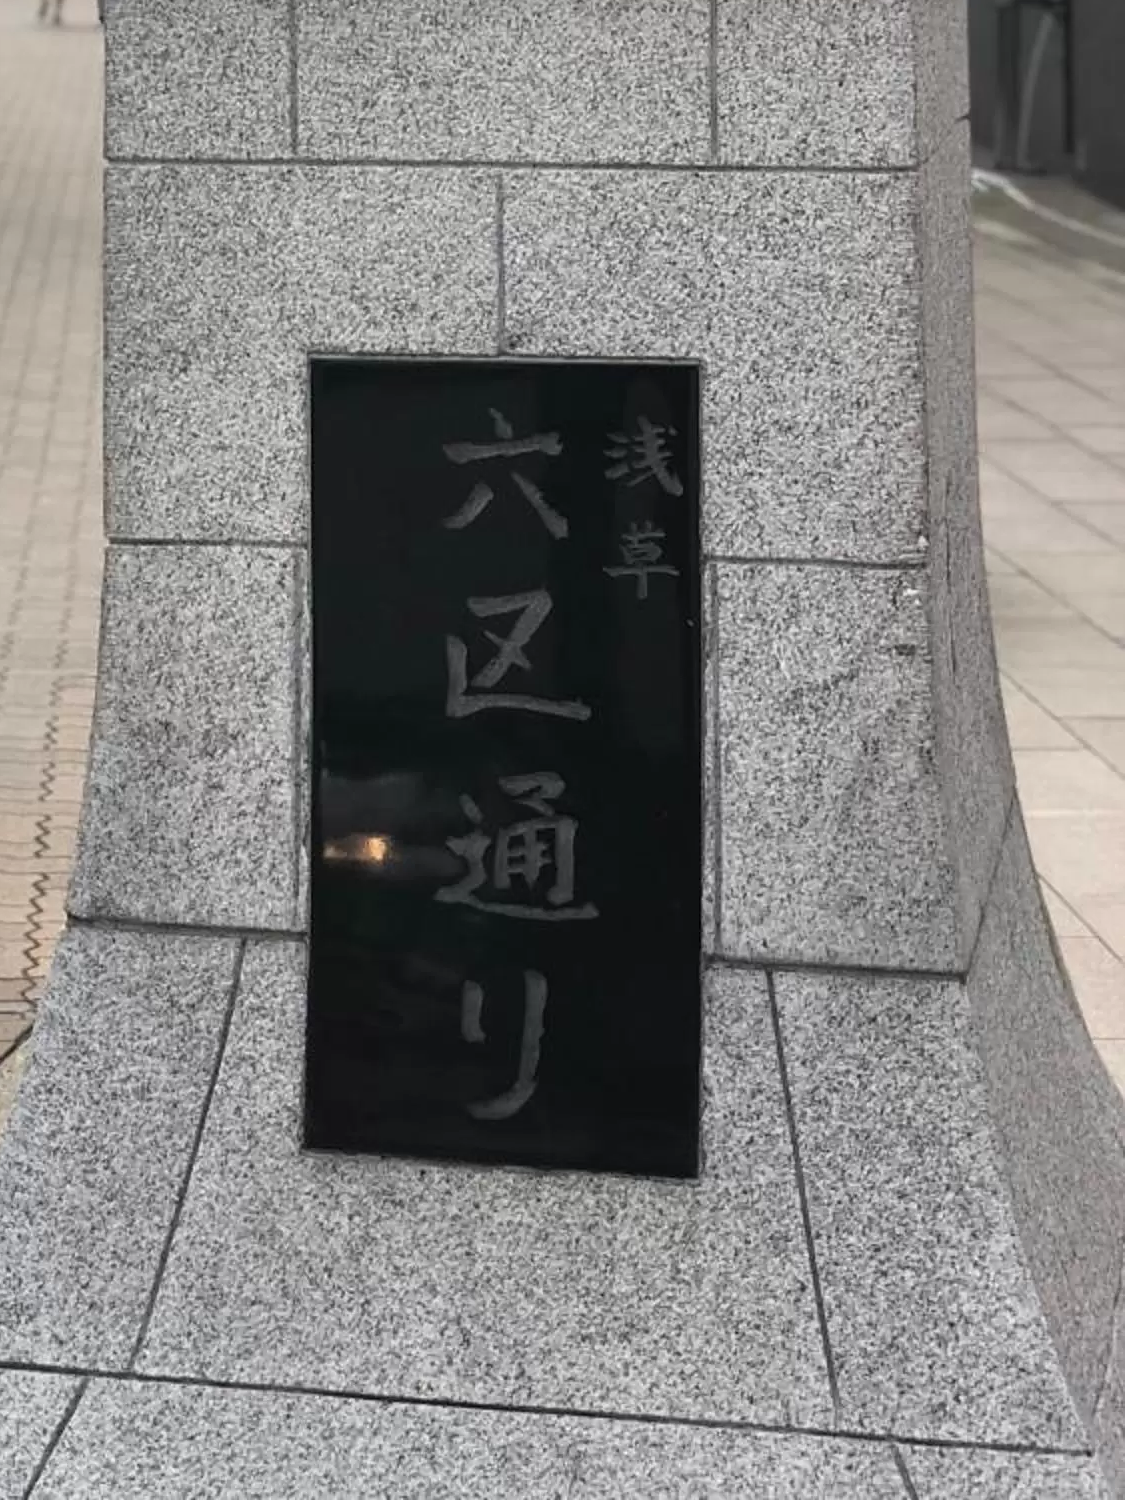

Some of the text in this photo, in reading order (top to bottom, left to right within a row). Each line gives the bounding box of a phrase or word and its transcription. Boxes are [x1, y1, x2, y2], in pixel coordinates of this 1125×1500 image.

[603, 415, 684, 599] 浅草
[435, 408, 600, 1120] 六区通り
